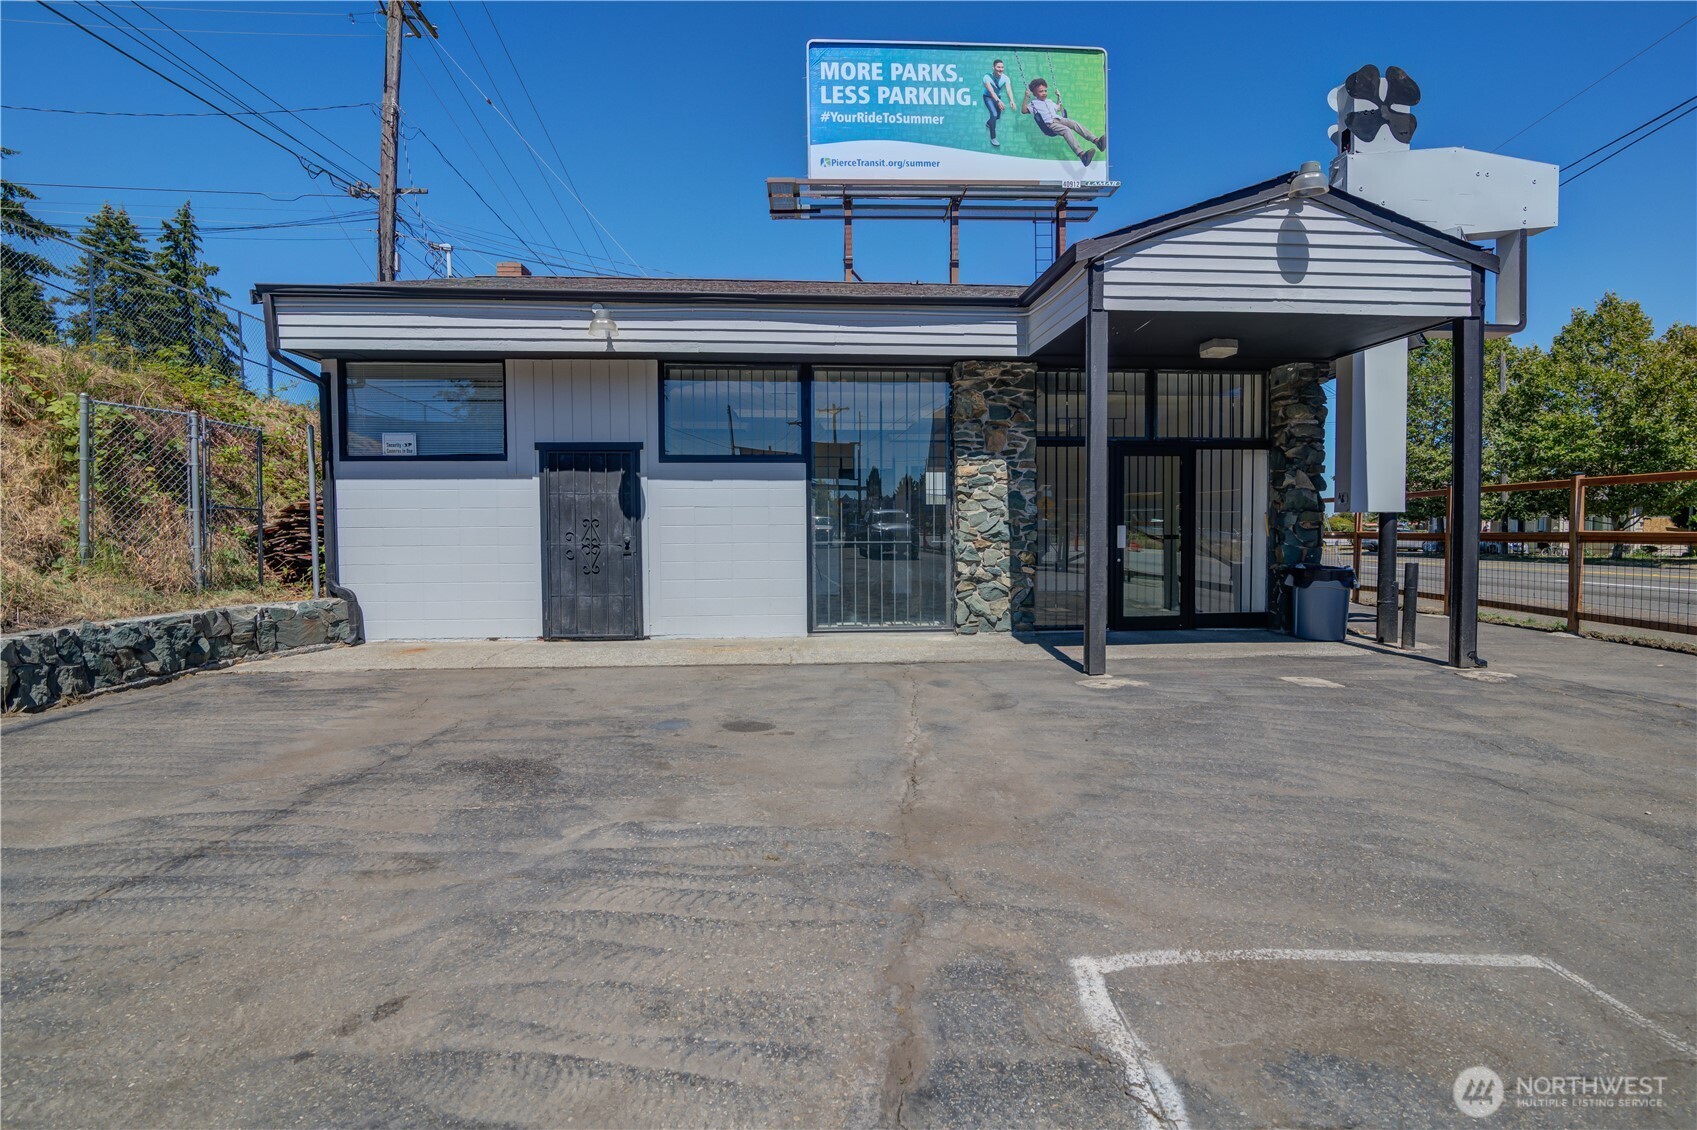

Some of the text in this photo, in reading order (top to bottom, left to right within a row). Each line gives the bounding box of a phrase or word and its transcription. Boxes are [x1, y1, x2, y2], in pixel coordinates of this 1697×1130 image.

[820, 61, 963, 82] MORE PARKS.
[820, 85, 977, 106] LESS PARKING.
[820, 111, 944, 125] #YourRideToSummer
[831, 158, 940, 169] PierceTransit.org/summer
